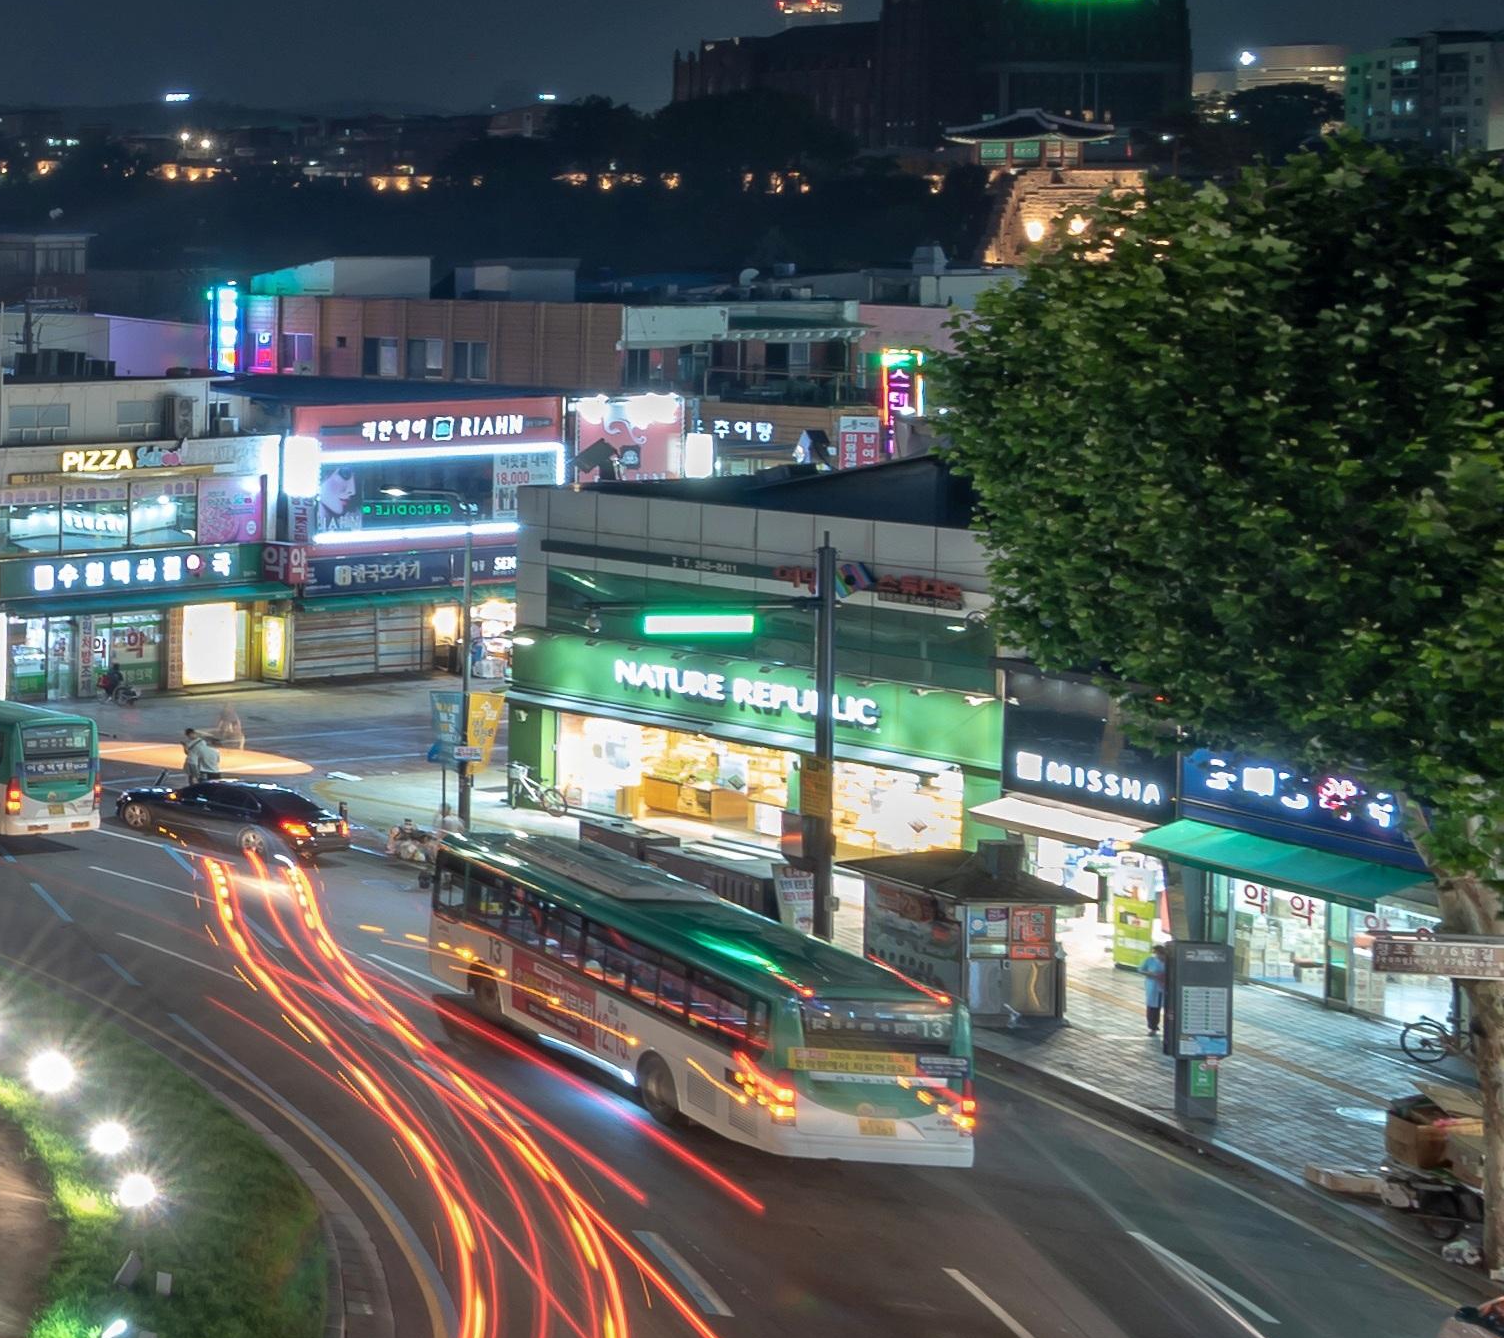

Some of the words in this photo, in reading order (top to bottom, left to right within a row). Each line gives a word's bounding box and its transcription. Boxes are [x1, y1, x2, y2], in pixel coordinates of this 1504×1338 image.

[460, 415, 524, 437] RIAHN
[714, 420, 773, 443] 추어탕
[62, 449, 133, 472] PIZZA
[263, 547, 288, 581] 약
[290, 547, 308, 581] 약
[352, 561, 421, 584] 한국도자기
[126, 631, 146, 659] 약
[615, 659, 726, 701] NATURE
[1046, 762, 1160, 805] MISSHA
[1244, 884, 1269, 915] 약
[1290, 895, 1317, 926] 약
[488, 937, 503, 965] 13
[921, 1022, 944, 1038] 13
